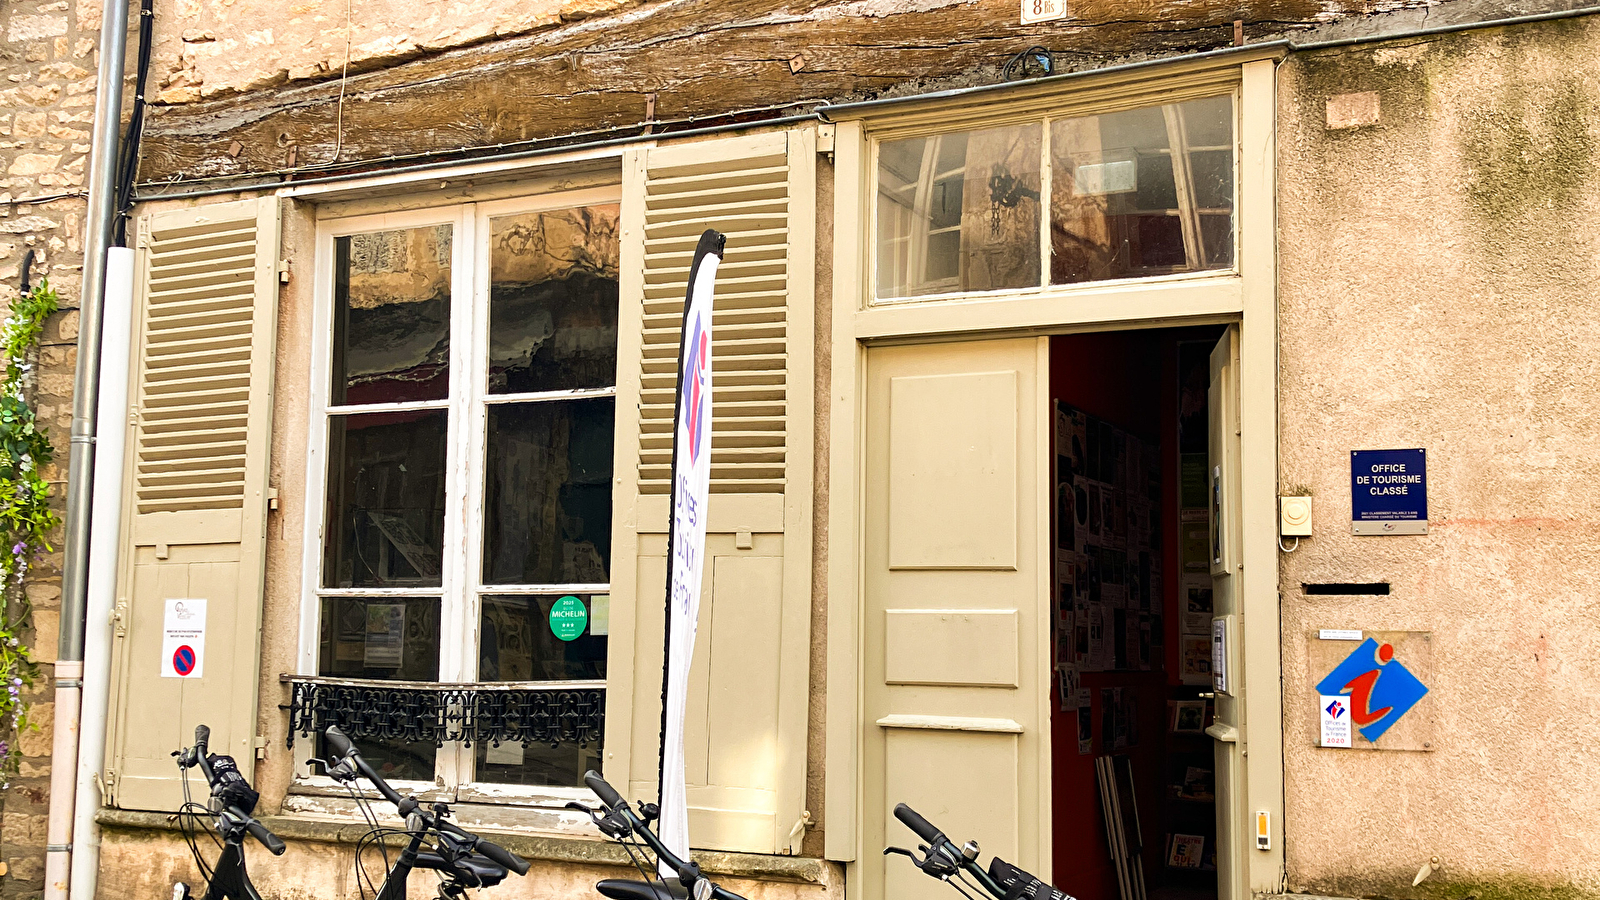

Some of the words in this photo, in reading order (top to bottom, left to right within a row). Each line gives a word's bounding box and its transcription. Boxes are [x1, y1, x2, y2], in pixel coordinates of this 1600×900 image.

[1033, 0, 1042, 15] 8
[1371, 464, 1406, 473] OFFICE
[1356, 476, 1370, 484] DE
[1371, 475, 1421, 484] TOURISME
[1370, 484, 1408, 495] CLASSÉ
[552, 610, 585, 618] MICHELIN
